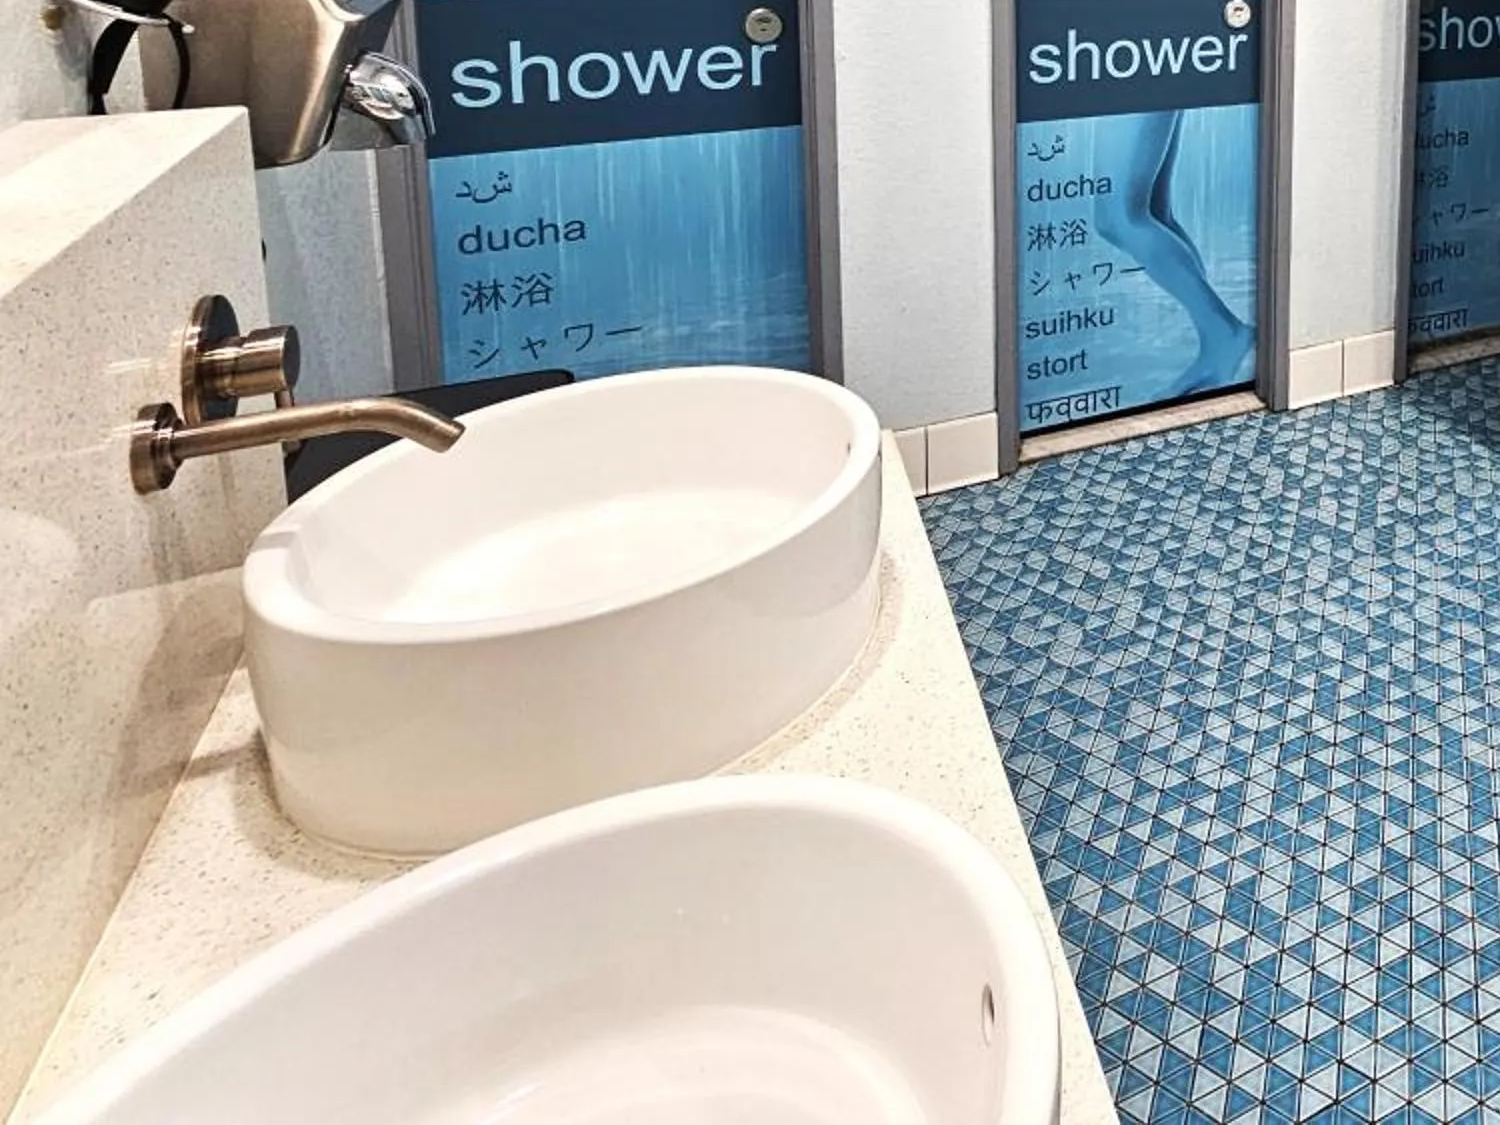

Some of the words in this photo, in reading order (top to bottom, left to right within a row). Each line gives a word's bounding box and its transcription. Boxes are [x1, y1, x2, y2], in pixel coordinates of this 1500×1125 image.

[1029, 28, 1248, 85] shower
[450, 40, 779, 108] shower
[1417, 127, 1469, 149] ucha
[1027, 174, 1112, 202] ducha
[458, 217, 586, 254] ducha
[1027, 218, 1088, 252] 淋浴
[1413, 241, 1465, 263] uihku
[460, 273, 555, 316] 淋浴
[1030, 262, 1146, 296] シャワー
[1411, 277, 1443, 298] tort
[1025, 305, 1114, 339] suihku
[467, 322, 643, 369] シャワー
[1027, 349, 1088, 380] stort
